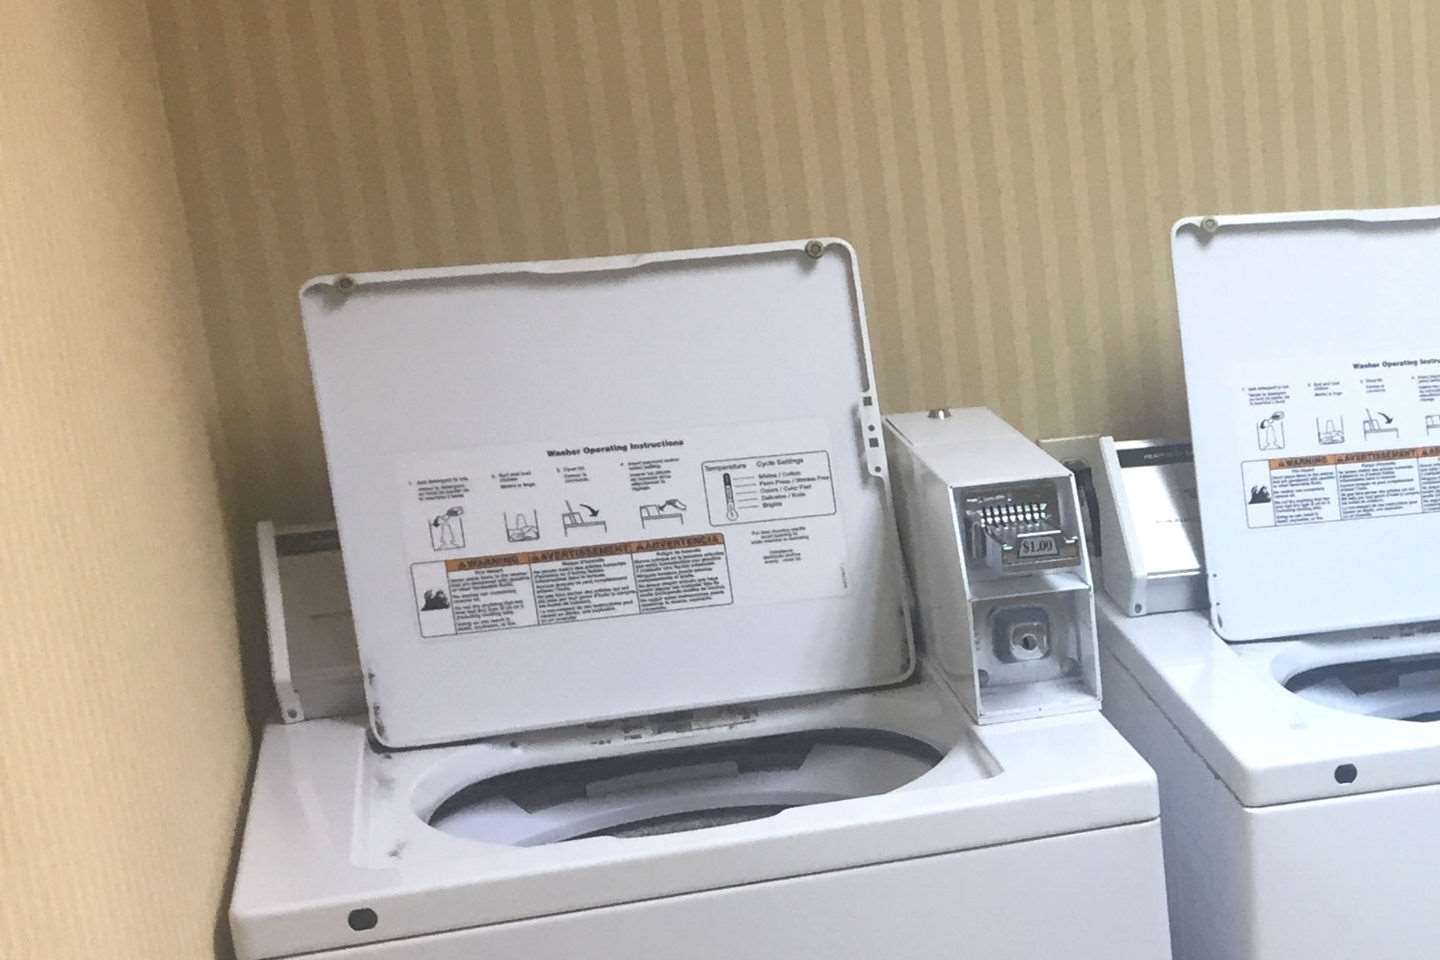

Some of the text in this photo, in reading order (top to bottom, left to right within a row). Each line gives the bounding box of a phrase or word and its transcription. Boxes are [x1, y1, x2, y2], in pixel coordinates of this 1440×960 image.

[547, 439, 684, 457] Washer Operating Instructions
[756, 458, 804, 468] Cycle Settings
[1286, 456, 1328, 466] WARNING
[1022, 538, 1054, 554] $1.00
[465, 555, 519, 568] WARNING
